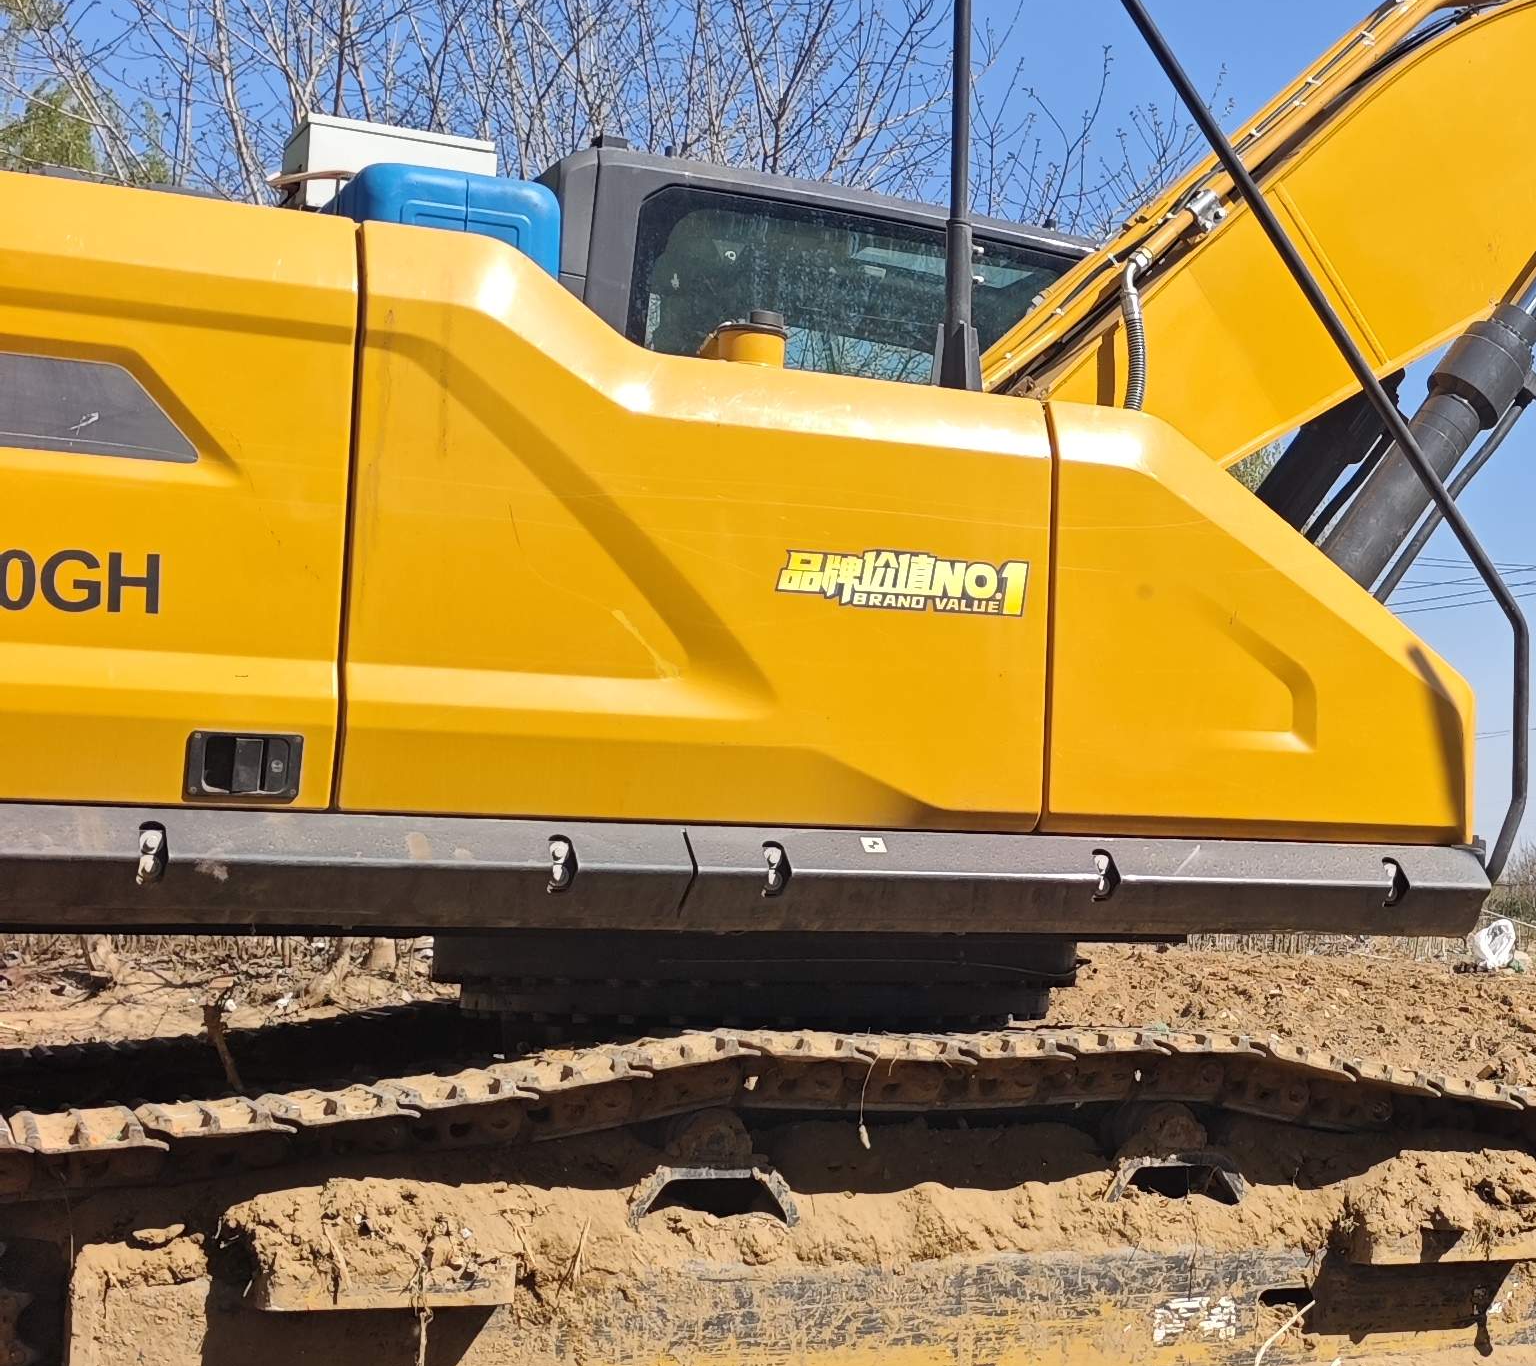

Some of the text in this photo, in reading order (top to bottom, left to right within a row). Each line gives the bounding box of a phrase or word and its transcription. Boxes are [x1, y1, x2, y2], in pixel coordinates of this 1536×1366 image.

[0, 549, 160, 614] 0GH
[853, 592, 1000, 613] BRAND VALUE
